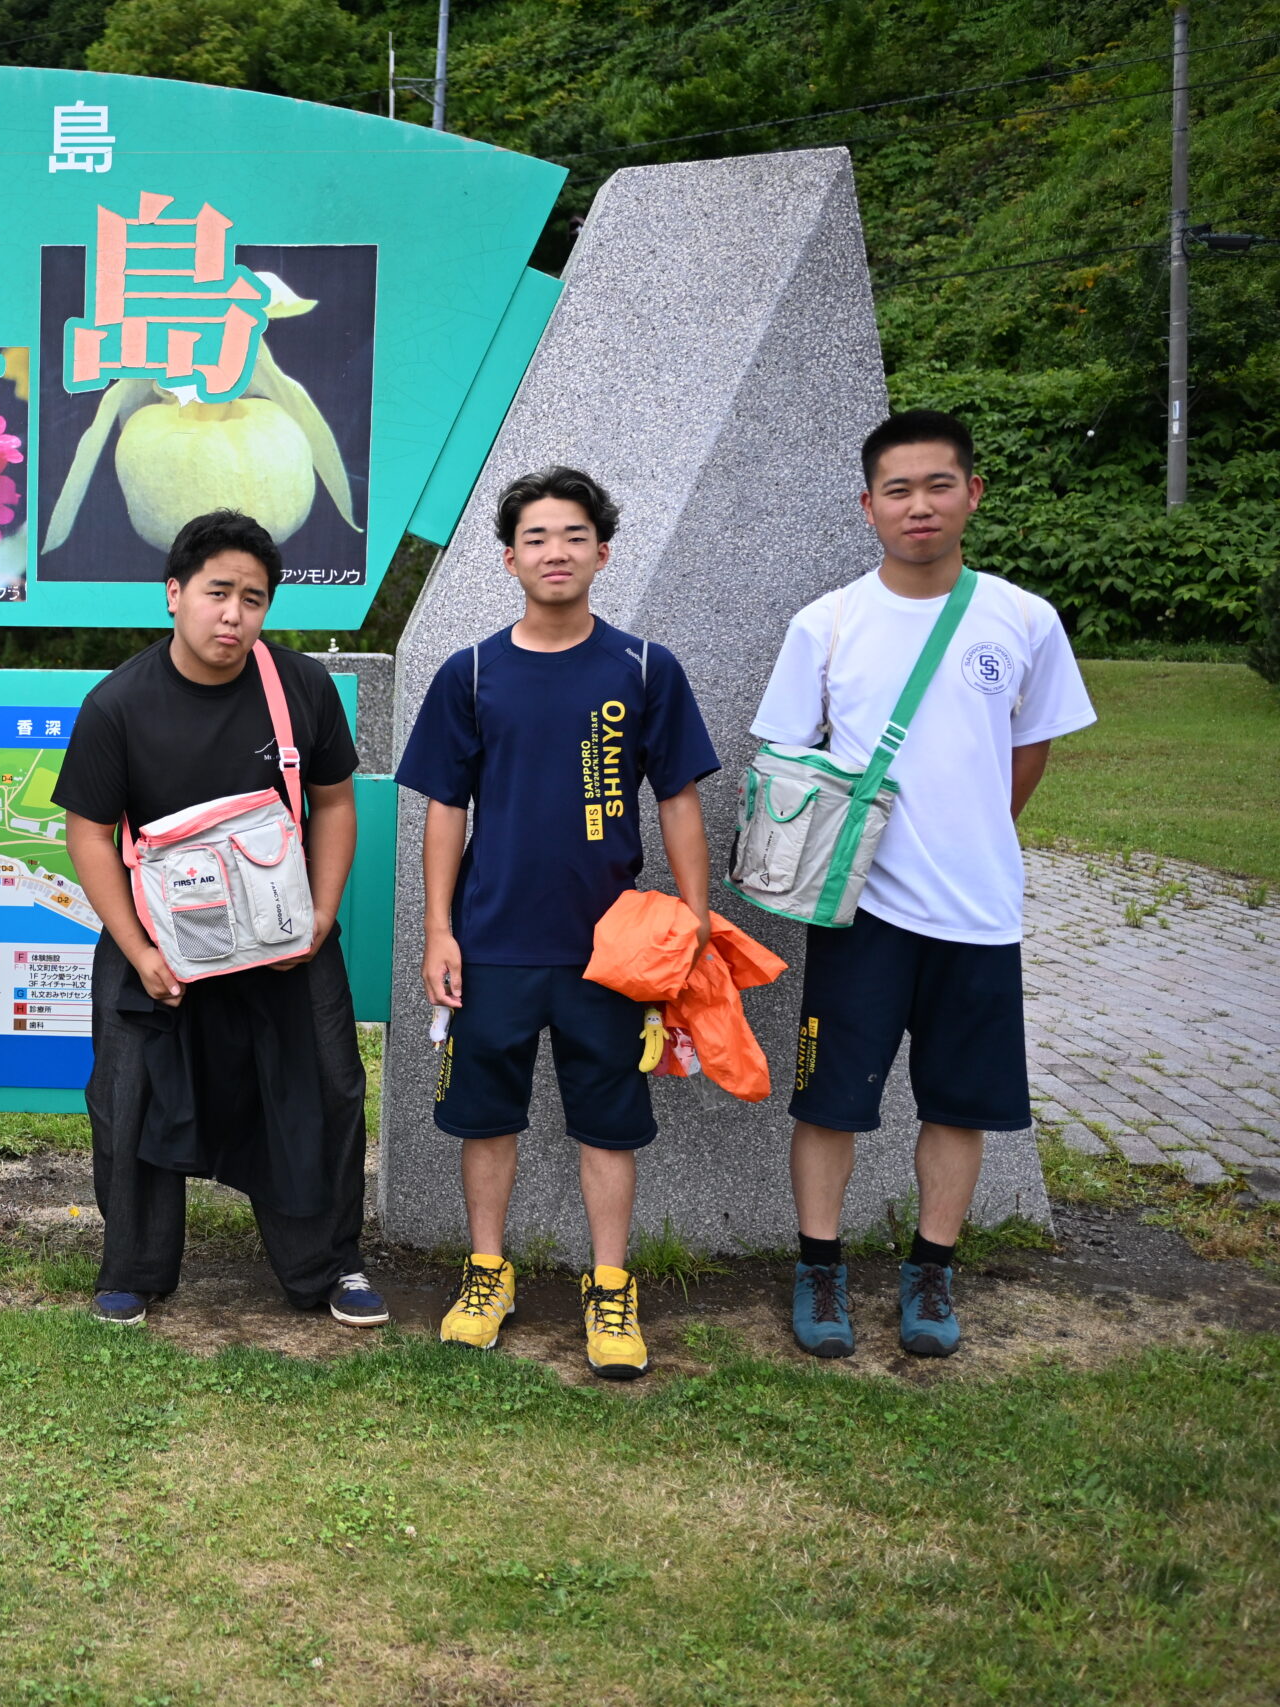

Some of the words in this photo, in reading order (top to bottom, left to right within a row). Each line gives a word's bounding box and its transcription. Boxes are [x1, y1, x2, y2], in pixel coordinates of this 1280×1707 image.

[17, 719, 77, 736] 香深
[601, 700, 626, 818] SHINYO
[581, 740, 594, 799] SAPPORO
[588, 808, 600, 836] SHS
[173, 878, 197, 888] FIRST
[200, 875, 216, 884] AID
[57, 896, 70, 904] D-2
[270, 881, 280, 902] FANCY
[275, 904, 284, 926] GOODS
[29, 964, 86, 972] 礼文町民センター
[40, 973, 93, 981] ブック愛ランドれ
[40, 981, 86, 989] ネイチャー礼文
[29, 1005, 52, 1013] 診療所
[809, 1040, 818, 1074] SAPPORO
